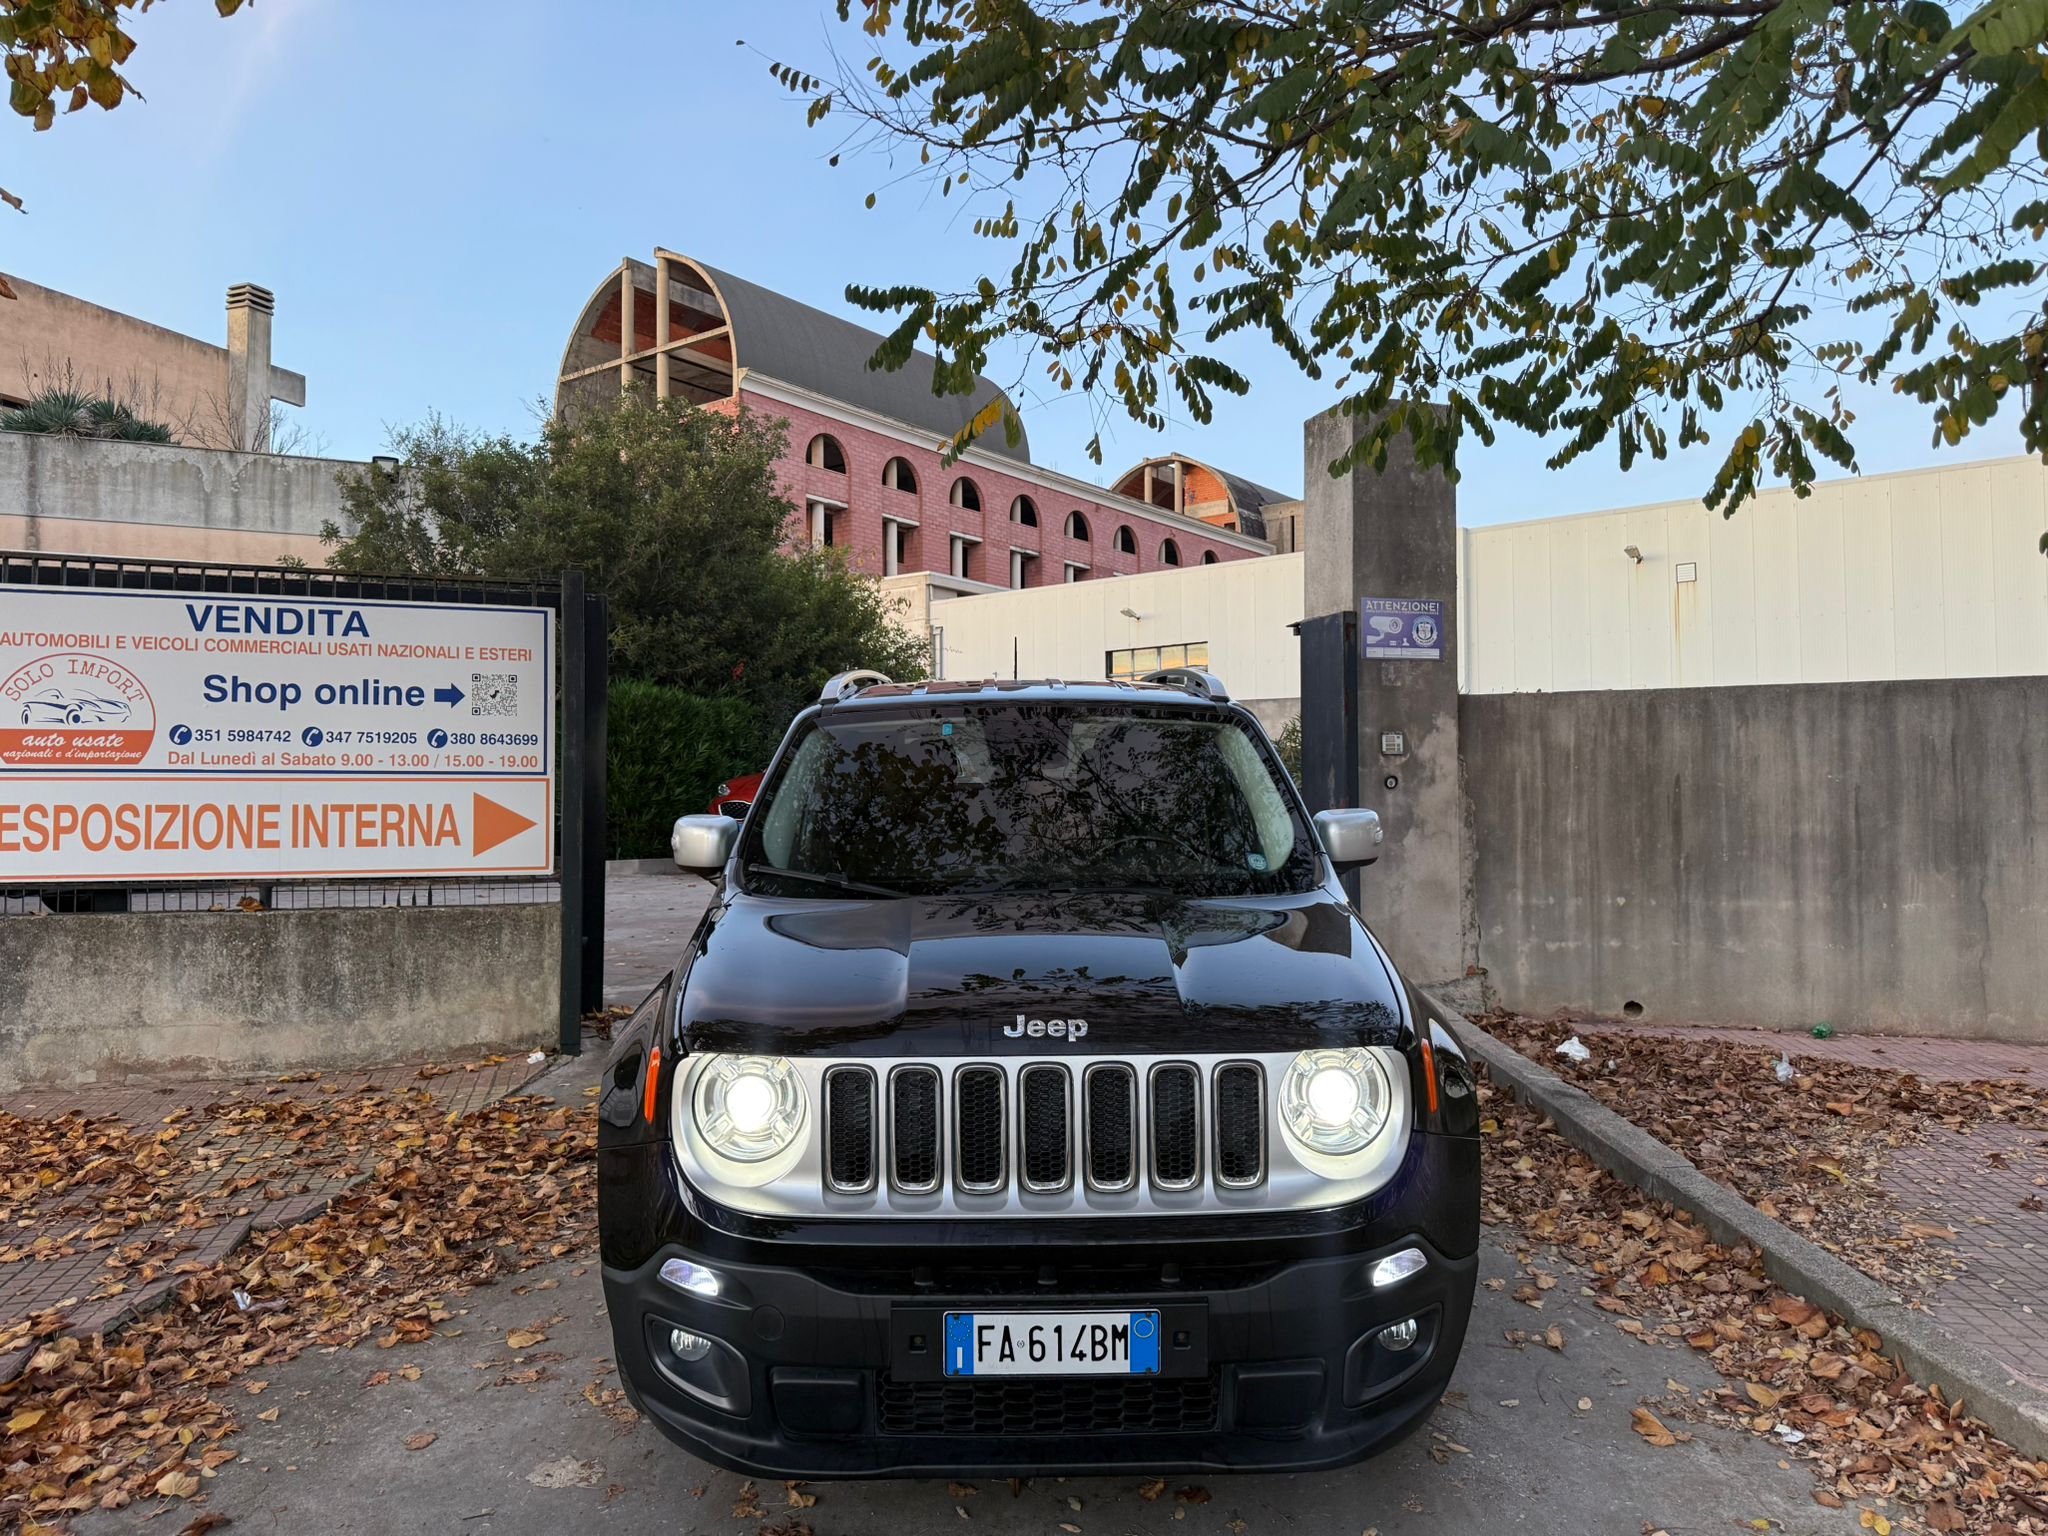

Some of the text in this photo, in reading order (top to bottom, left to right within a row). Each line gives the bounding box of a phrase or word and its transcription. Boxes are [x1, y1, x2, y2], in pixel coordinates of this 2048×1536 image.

[1366, 600, 1440, 613] ATTENZIONE!
[185, 604, 370, 638] VENDITA
[0, 632, 532, 662] AUTOMOBILI E VEICOLI COMMERCIALI USATI NAZIONALI E ESTERI
[5, 659, 145, 702] SOLO IMPORT
[203, 674, 425, 711] Shop online
[22, 732, 125, 748] auto usate
[195, 729, 292, 742] 351 5984742
[326, 731, 417, 744] 347 7519205
[450, 733, 539, 745] 380 8643699
[3, 748, 143, 761] nazionali e d'importazione
[168, 751, 195, 765] Dal
[201, 751, 256, 766] Lunedì
[261, 752, 275, 765] al
[280, 752, 336, 766] Sabato
[341, 753, 374, 767] 9.00
[389, 754, 430, 767] 13.00
[433, 754, 440, 768] /
[444, 754, 484, 768] 15.00
[500, 755, 538, 768] 19.00
[0, 803, 462, 852] ESPOSIZIONE INTERNA
[1003, 1014, 1089, 1042] Jeep
